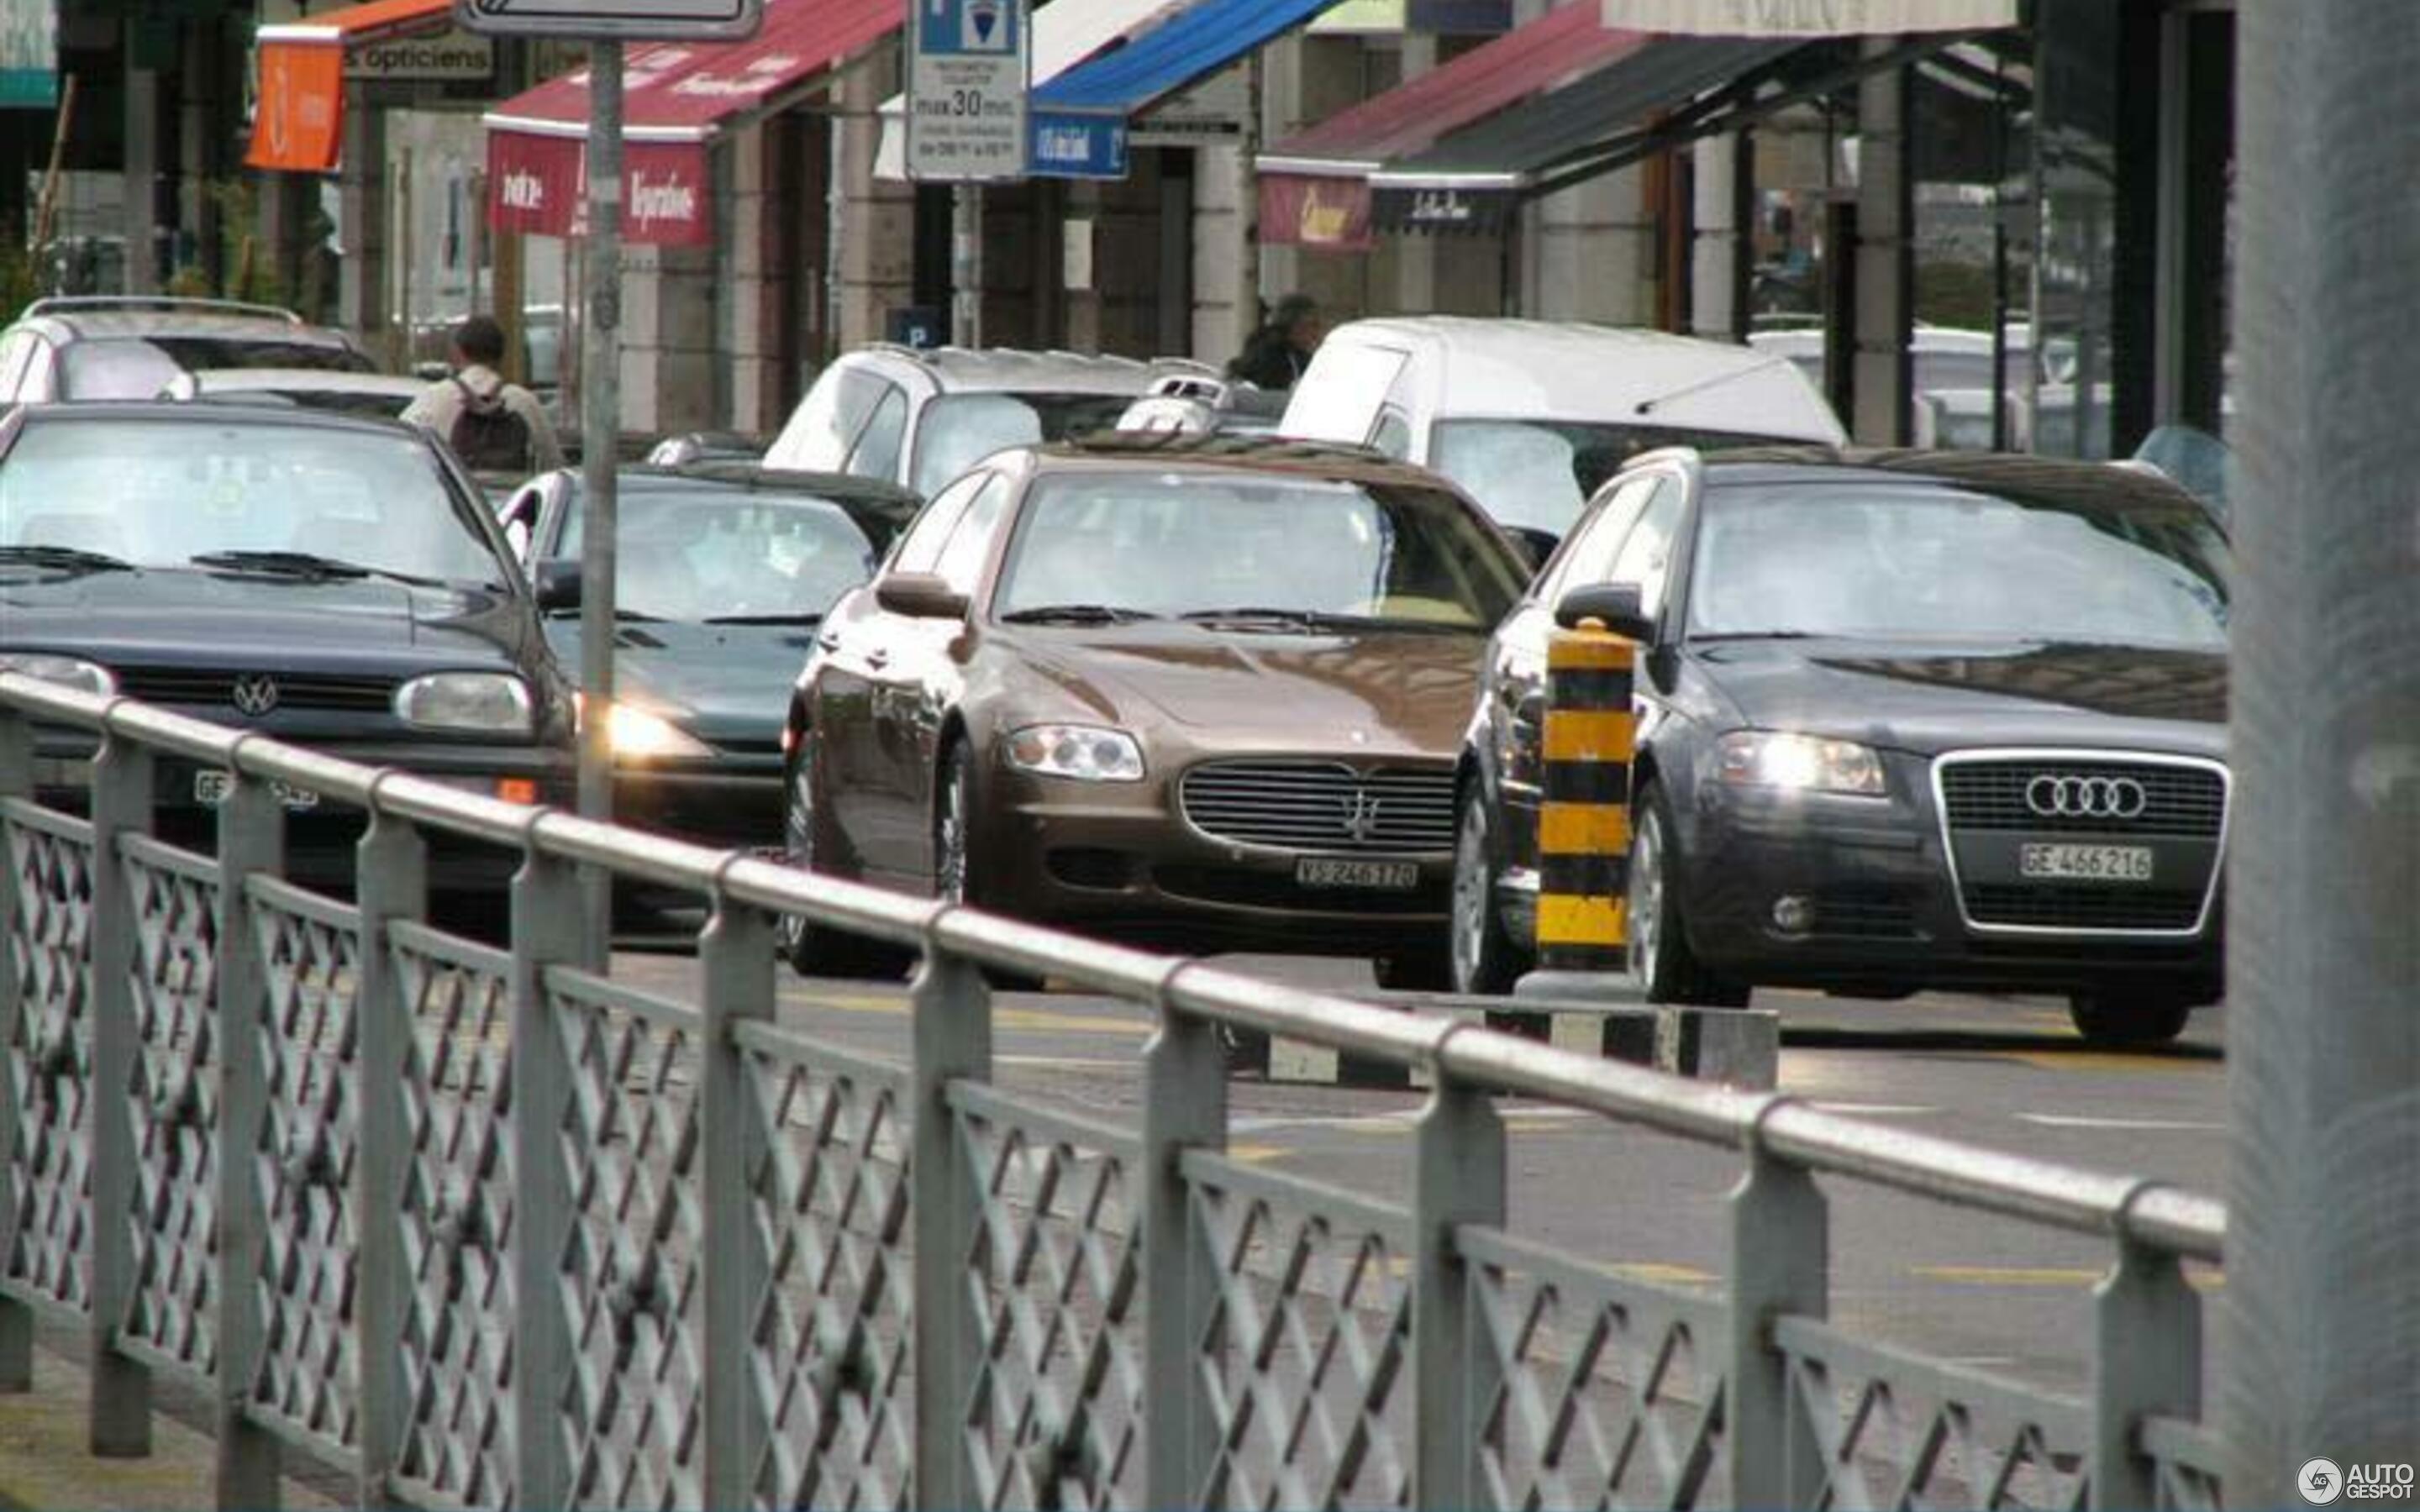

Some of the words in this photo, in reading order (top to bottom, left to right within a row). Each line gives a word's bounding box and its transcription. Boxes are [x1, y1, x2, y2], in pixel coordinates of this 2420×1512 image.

[365, 45, 488, 73] opticiens
[953, 90, 981, 116] 30
[2025, 846, 2054, 872] GE
[2060, 848, 2150, 875] 466216
